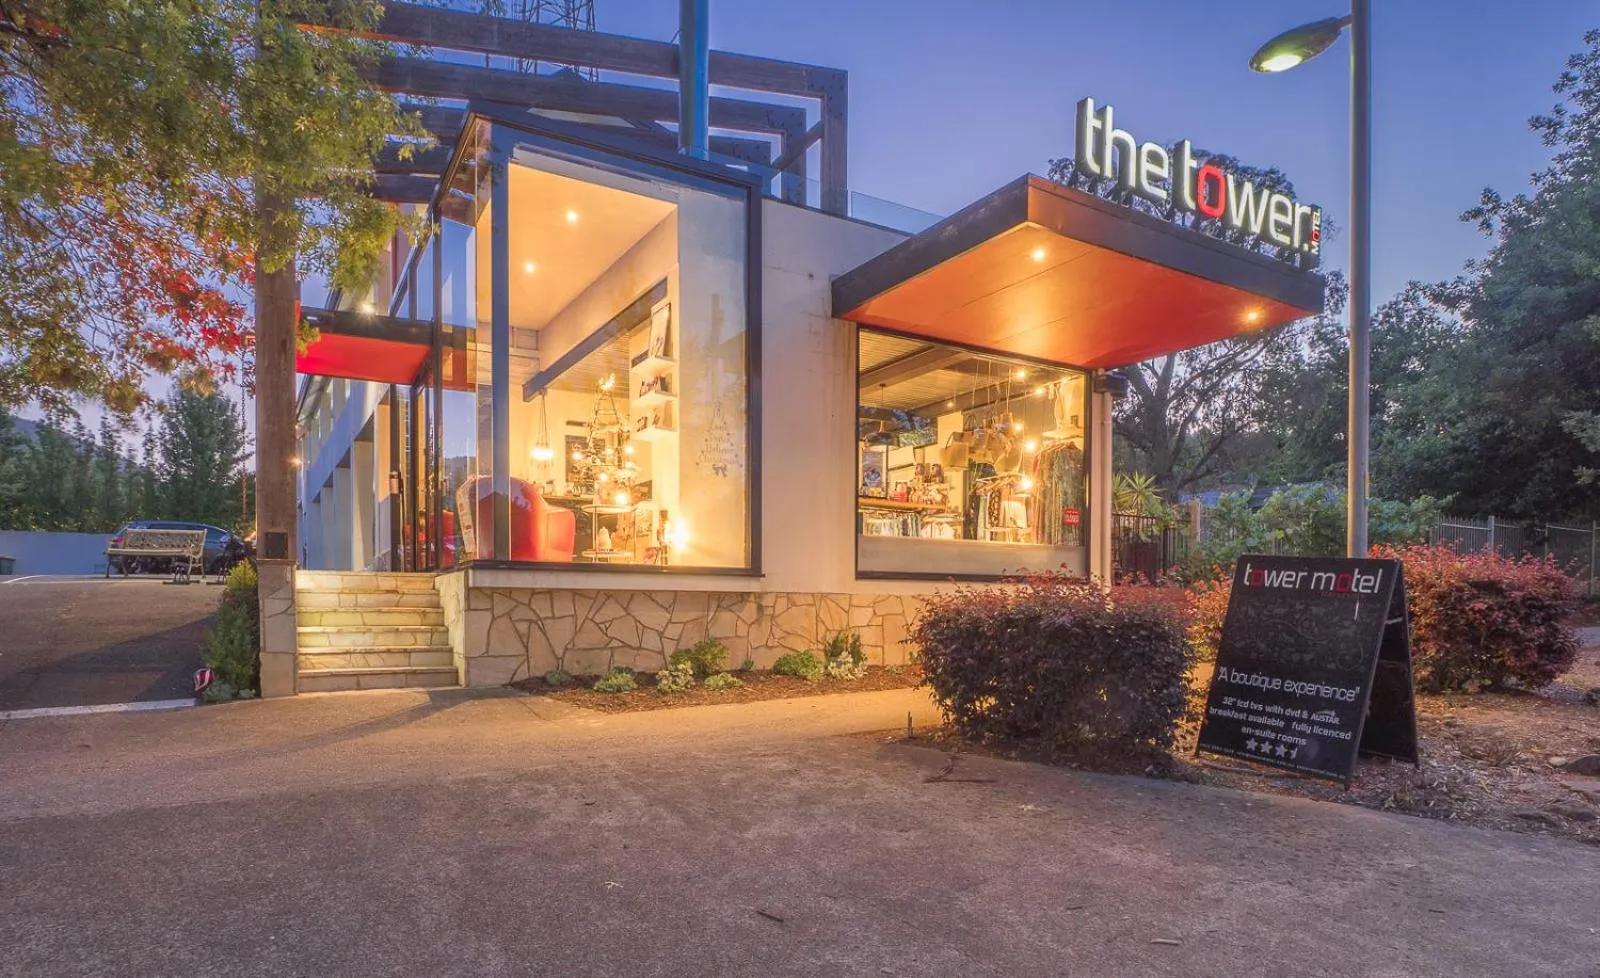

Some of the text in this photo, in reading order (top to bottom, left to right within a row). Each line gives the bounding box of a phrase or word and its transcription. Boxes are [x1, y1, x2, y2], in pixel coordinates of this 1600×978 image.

[1078, 96, 1168, 200] the
[1311, 207, 1321, 255] MOTEL
[1243, 563, 1382, 593] tower motel
[1231, 668, 1281, 692] boutique
[1209, 706, 1352, 740] breakfast available fully licenced
[1237, 699, 1250, 708] lcd
[1250, 701, 1264, 711] tvs
[1265, 704, 1284, 715] with
[1284, 707, 1301, 719] dvd
[1302, 710, 1308, 719] &
[1241, 726, 1307, 746] en-suite rooms
